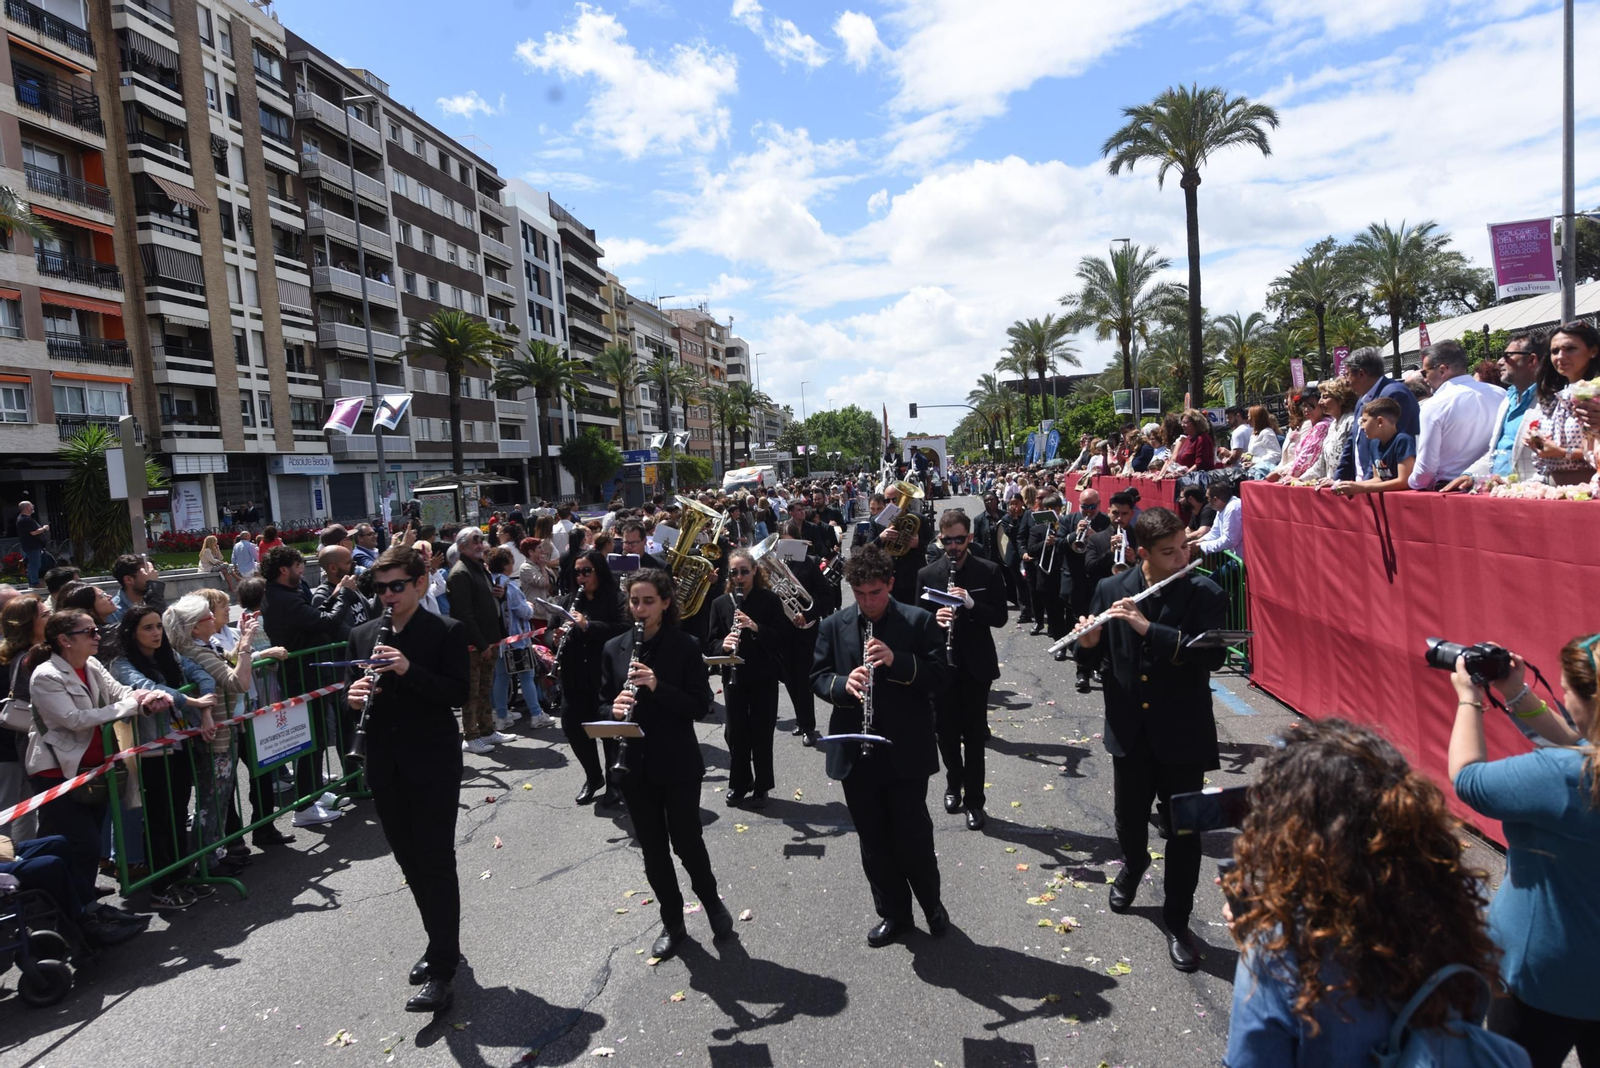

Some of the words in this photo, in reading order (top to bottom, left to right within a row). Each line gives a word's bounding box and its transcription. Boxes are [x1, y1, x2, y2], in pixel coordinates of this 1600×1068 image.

[1496, 227, 1539, 238] COLORES
[1497, 236, 1515, 244] DEL
[1516, 233, 1548, 242] MUNDO
[1506, 284, 1550, 292] CaixaForum
[288, 457, 312, 466] Absolute
[312, 457, 330, 468] Beauty
[260, 731, 285, 746] AYUNTAMIENTO
